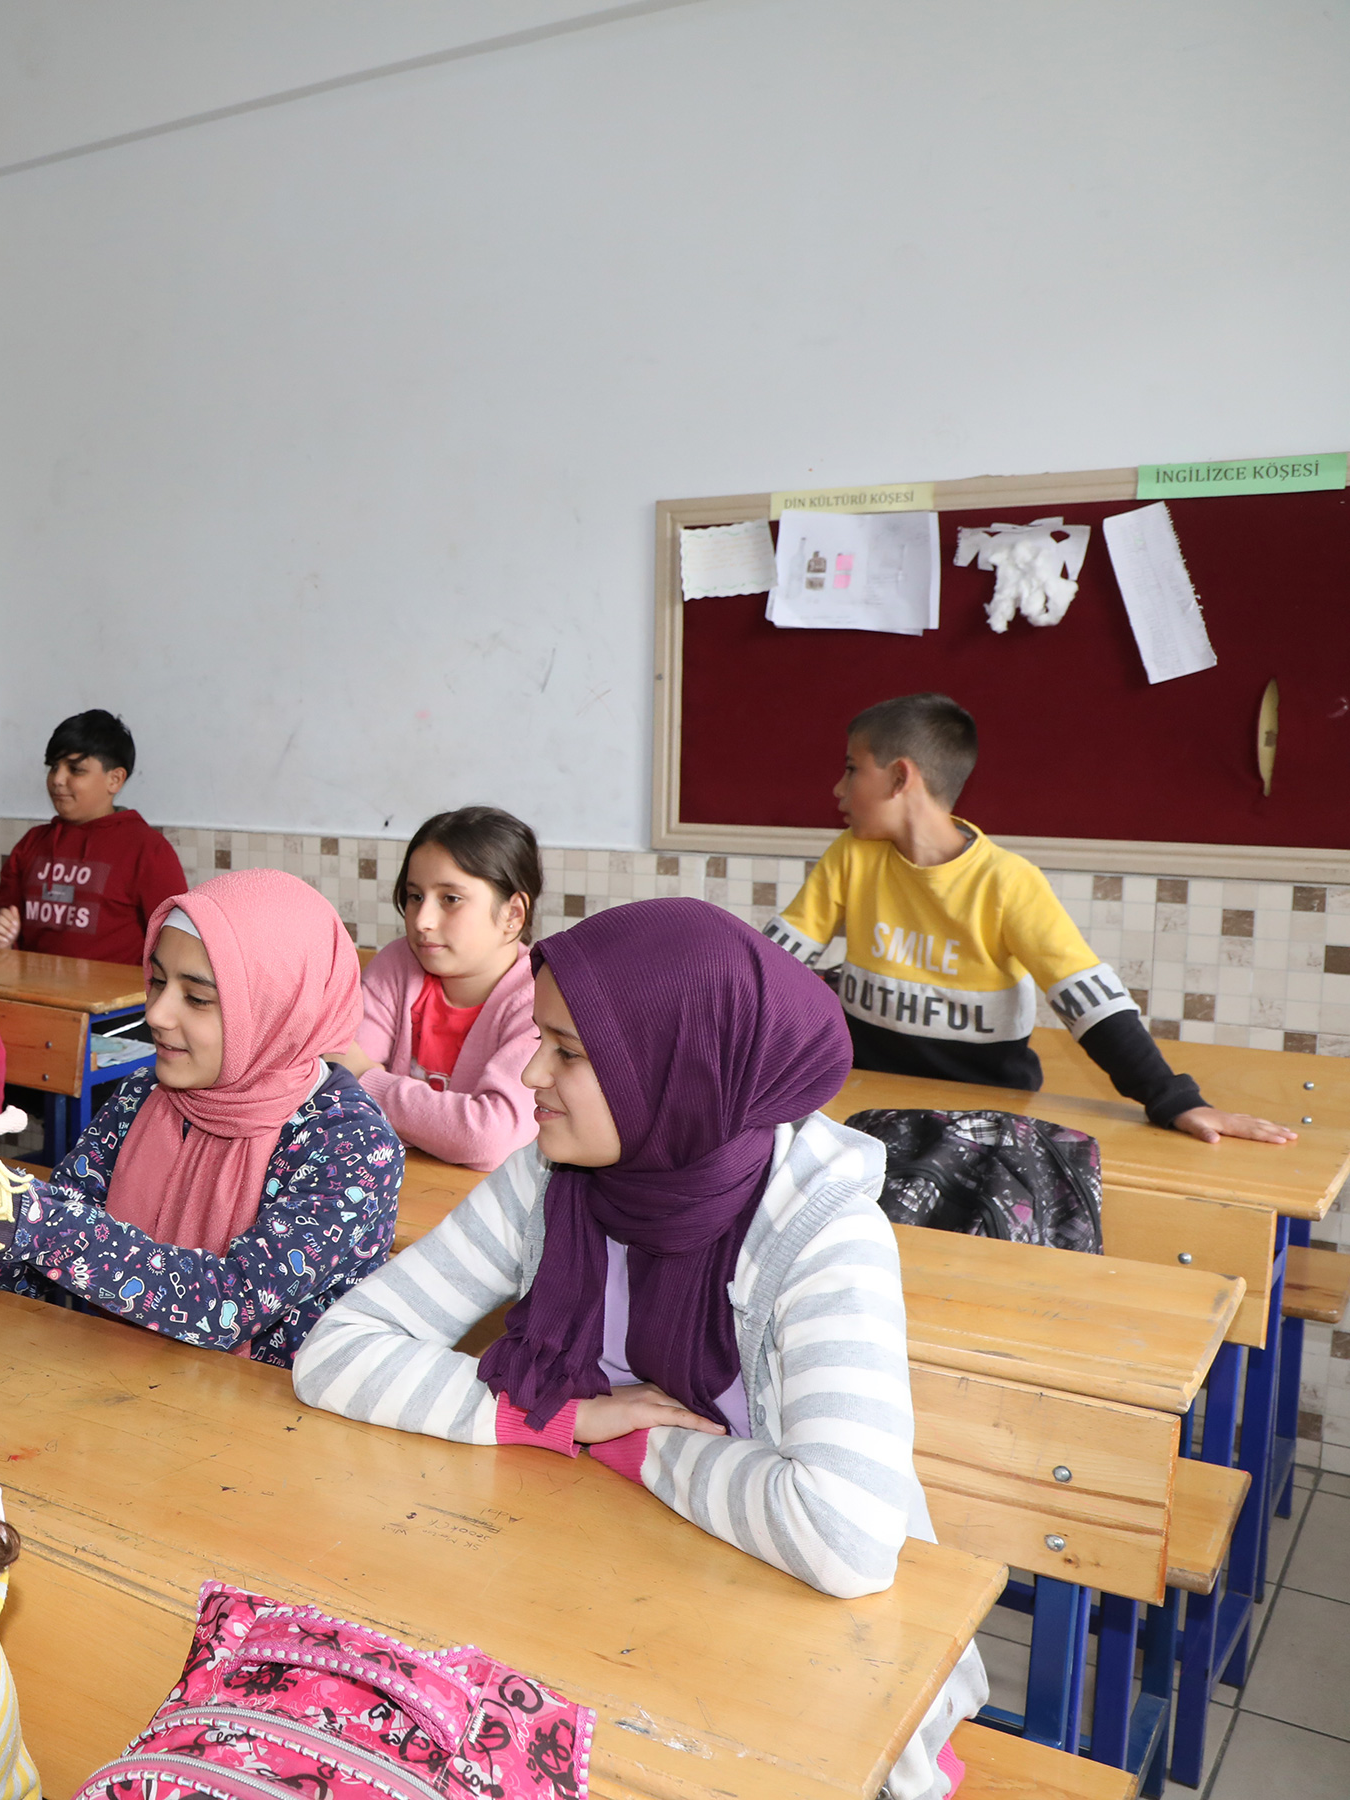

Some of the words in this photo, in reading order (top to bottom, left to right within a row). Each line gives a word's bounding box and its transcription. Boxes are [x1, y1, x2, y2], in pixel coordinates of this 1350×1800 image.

[1155, 465, 1247, 484] İNGİLİZCE
[1252, 460, 1320, 481] KÖŞESİ
[784, 497, 806, 509] DİN
[37, 862, 92, 885] JOJO
[26, 900, 90, 928] MOYES
[871, 922, 961, 975] SMILE
[842, 970, 995, 1034] OUTHFUL
[1051, 974, 1125, 1032] MIL
[366, 1147, 395, 1163] BOOM!
